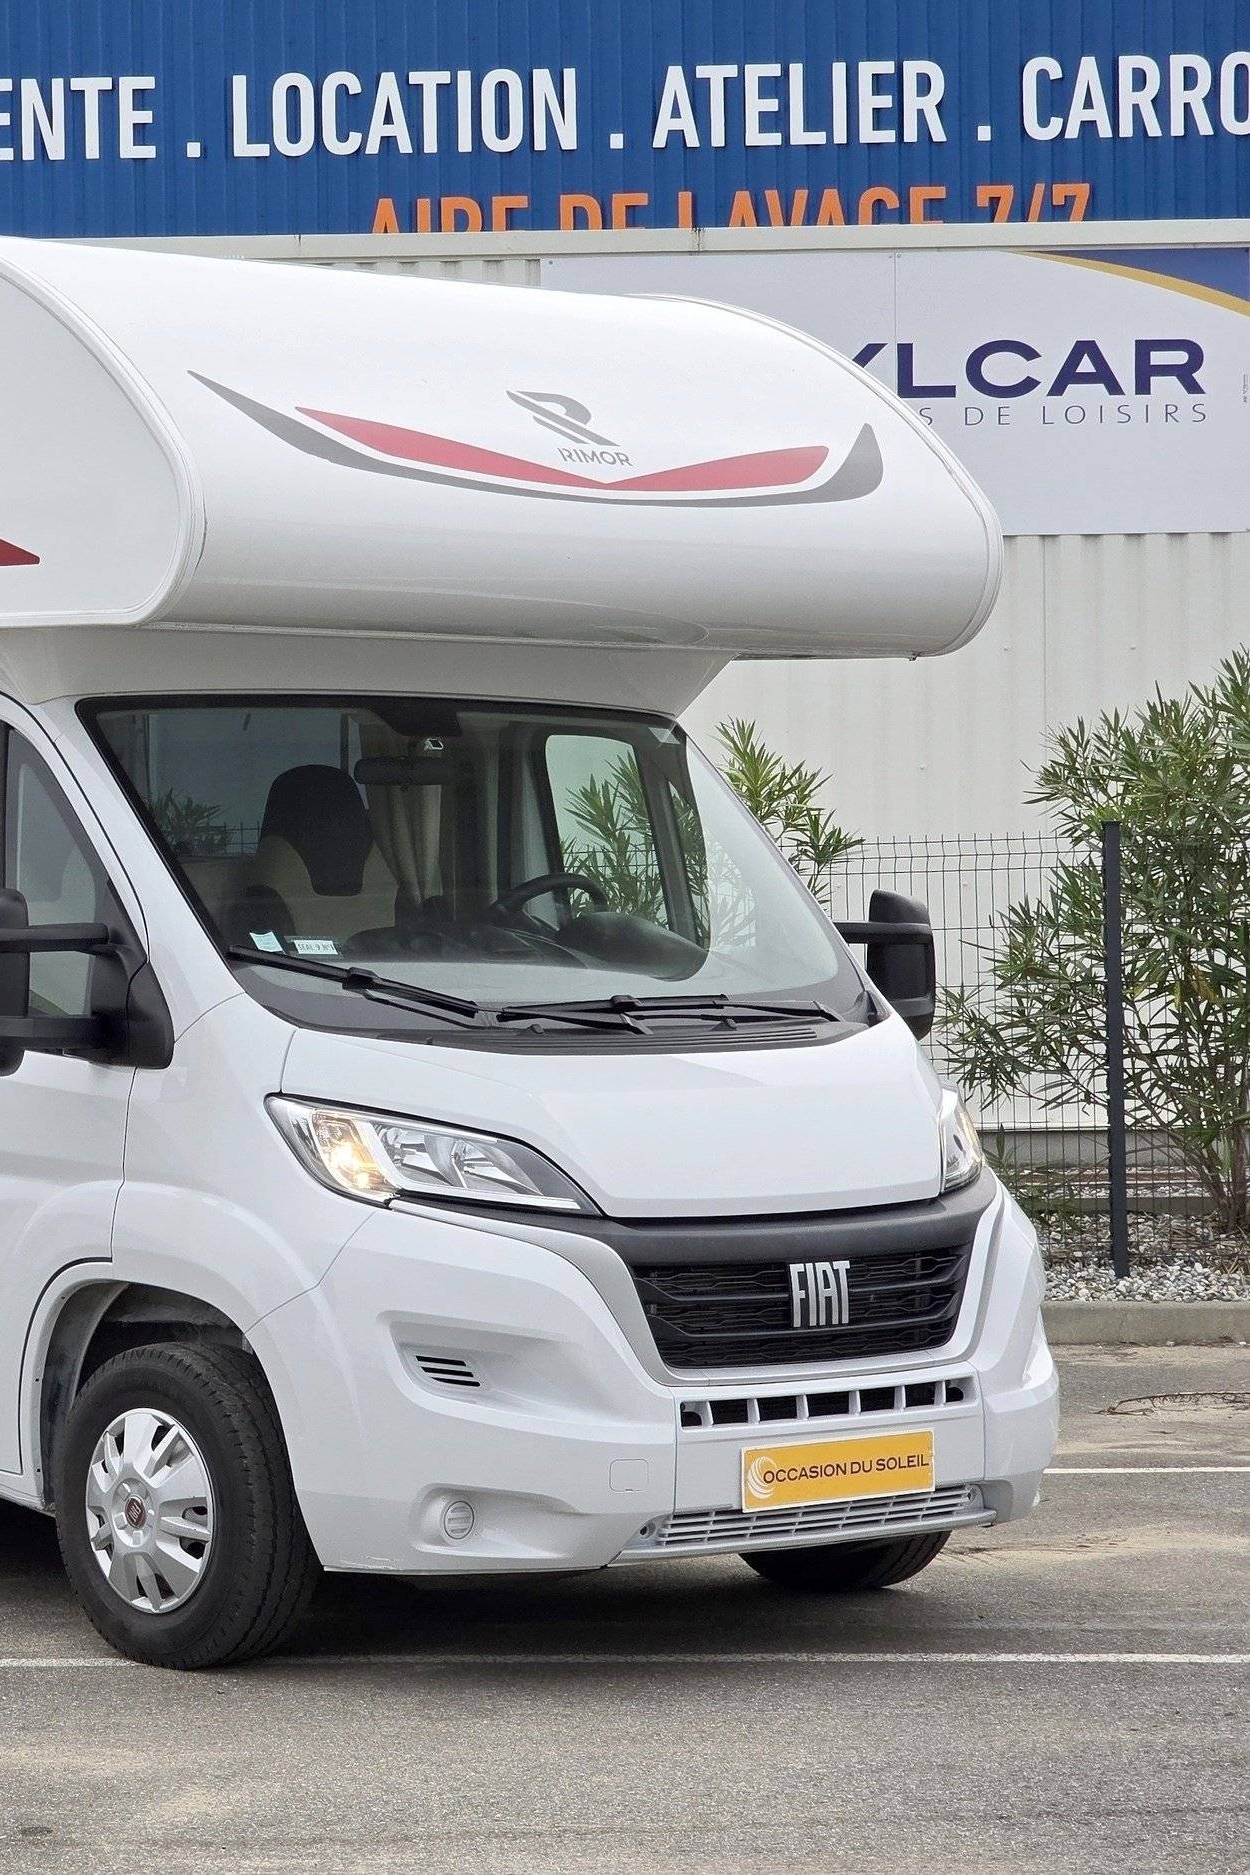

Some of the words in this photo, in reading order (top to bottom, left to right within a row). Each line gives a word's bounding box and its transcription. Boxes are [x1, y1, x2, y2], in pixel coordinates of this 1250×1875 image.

[232, 68, 578, 157] LOCATION
[652, 60, 947, 149] ATELIER
[964, 406, 1011, 426] DE
[1042, 403, 1207, 425] LOISIRS
[557, 447, 634, 467] RIMOR
[789, 1260, 851, 1328] FIAT
[763, 1462, 847, 1484] OCCASION
[850, 1460, 873, 1475] DU
[875, 1454, 930, 1472] SOLEIL
